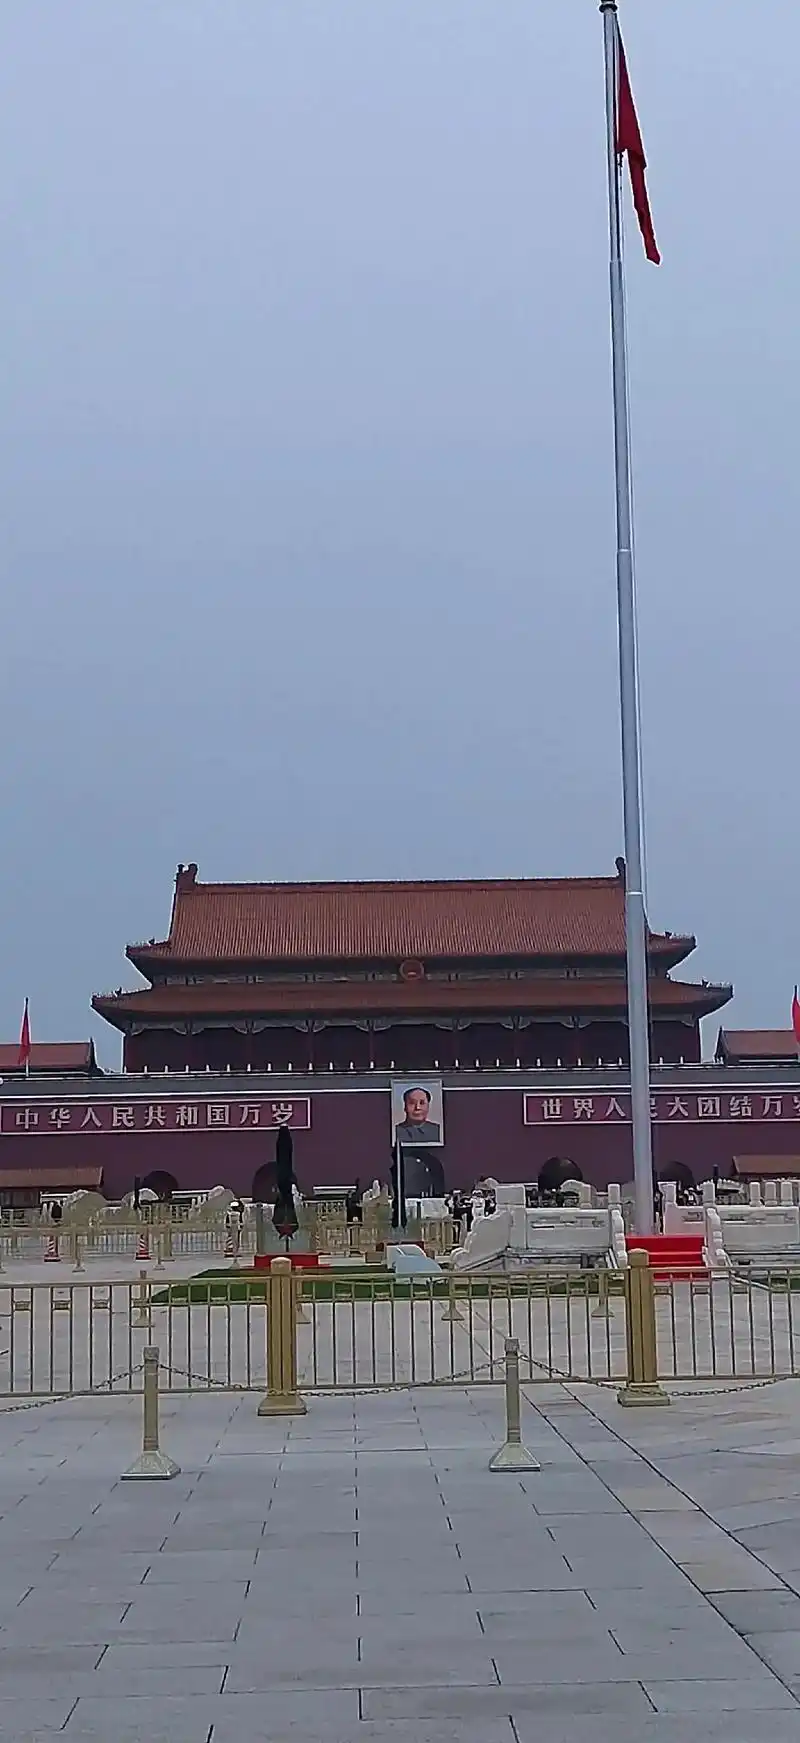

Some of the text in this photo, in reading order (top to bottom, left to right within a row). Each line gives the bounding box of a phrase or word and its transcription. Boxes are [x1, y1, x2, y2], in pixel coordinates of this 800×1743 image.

[15, 1103, 293, 1129] 中华人民共和国万岁
